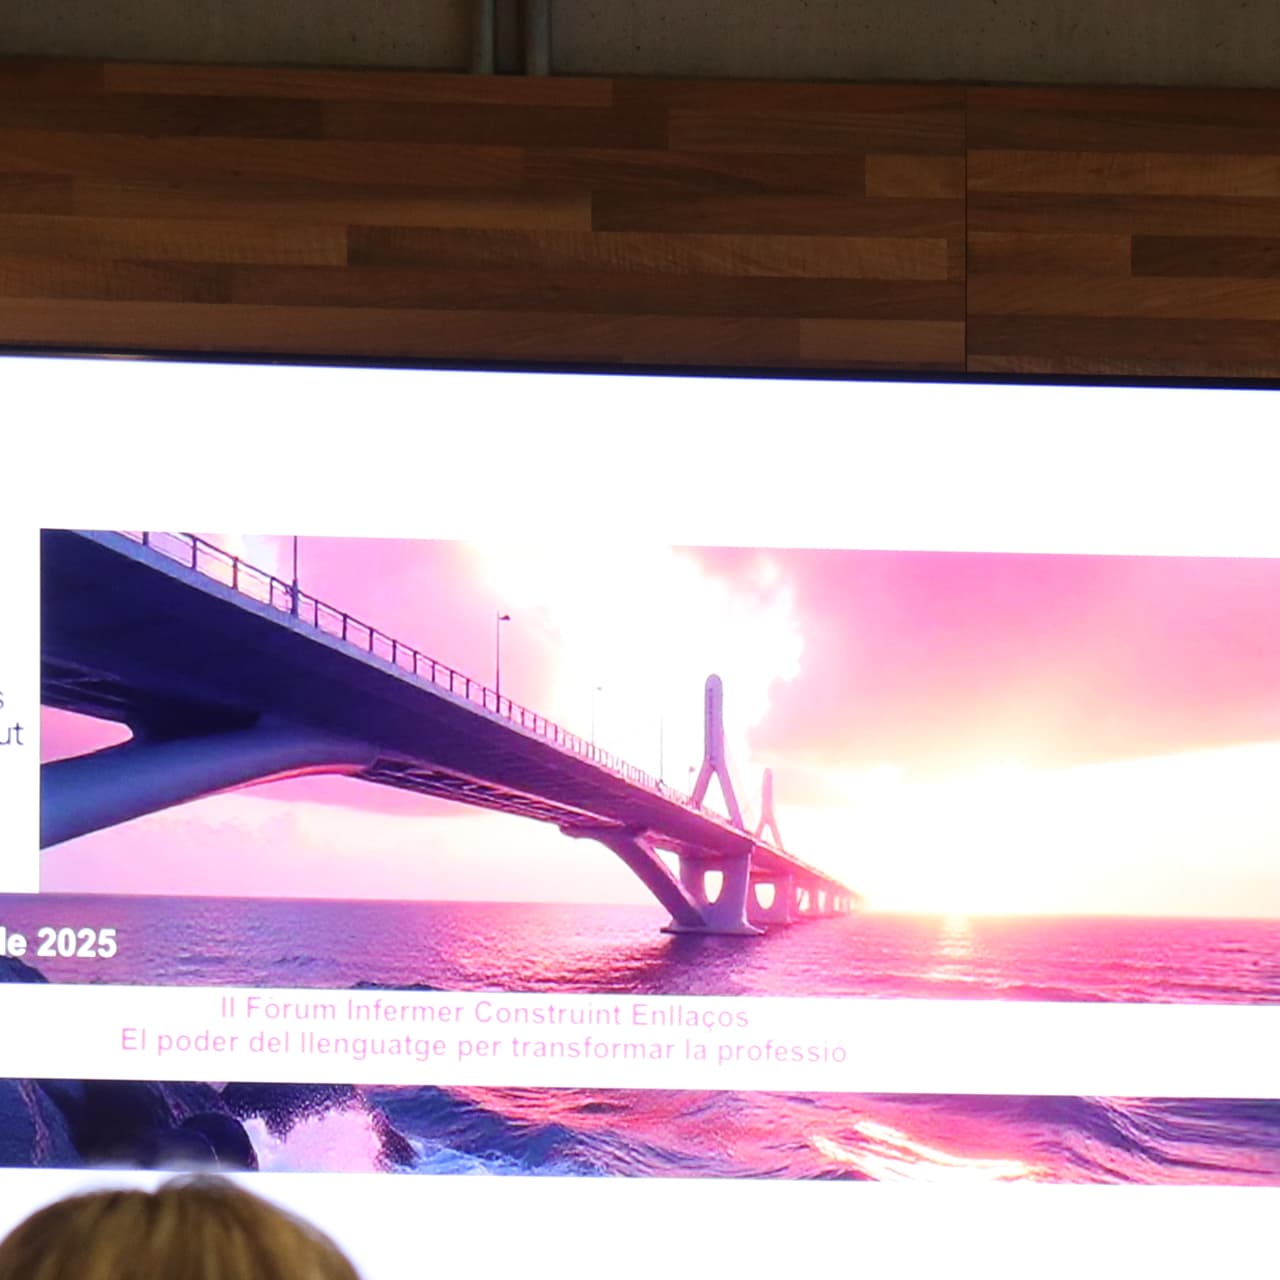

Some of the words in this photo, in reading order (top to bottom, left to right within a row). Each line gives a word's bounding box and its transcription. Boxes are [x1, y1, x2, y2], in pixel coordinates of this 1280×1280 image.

[37, 927, 118, 958] 2025
[221, 996, 235, 1019] II
[347, 998, 465, 1023] Infermer
[474, 1000, 622, 1026] Construint
[631, 1003, 750, 1032] Enllaços
[121, 1027, 147, 1051] El
[157, 1029, 239, 1057] poder
[248, 1030, 290, 1054] del
[300, 1031, 447, 1063] llenguatge
[457, 1039, 502, 1062] per
[511, 1035, 675, 1060] transformar
[685, 1038, 707, 1061] la
